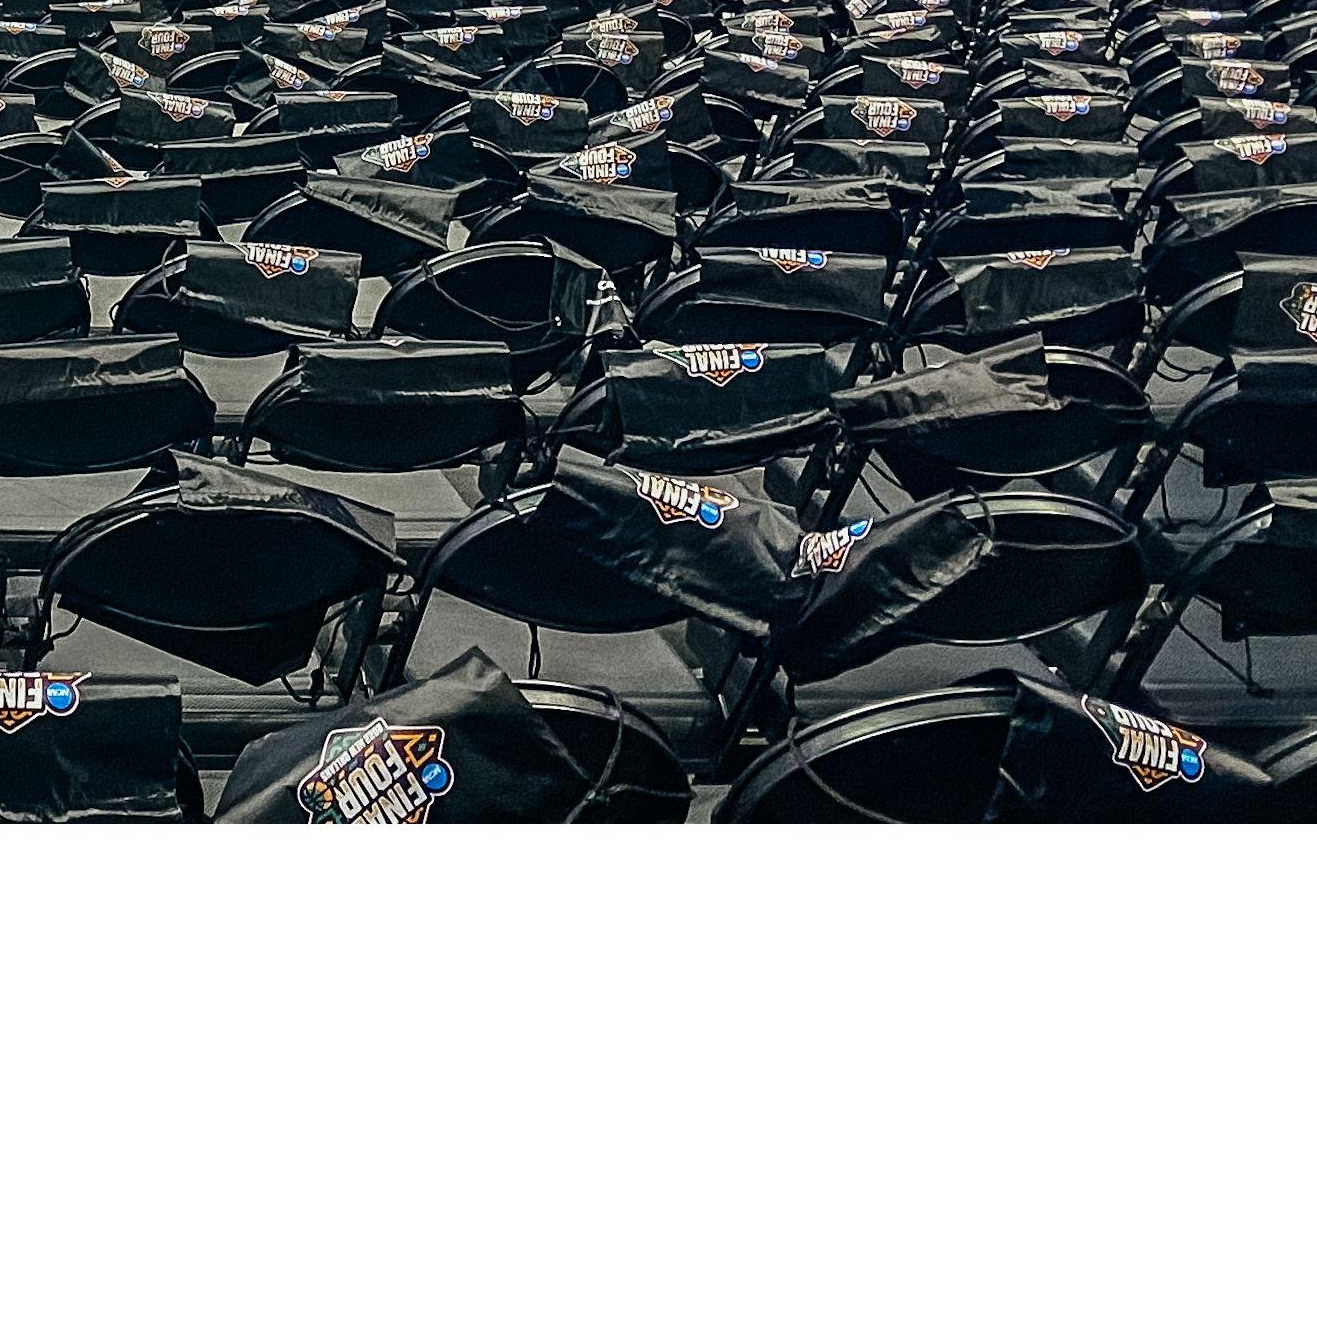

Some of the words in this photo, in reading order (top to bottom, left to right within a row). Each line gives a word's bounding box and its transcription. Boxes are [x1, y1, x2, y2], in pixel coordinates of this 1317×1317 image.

[686, 350, 741, 373] FINAL
[639, 475, 702, 514] FINAL
[1118, 722, 1181, 773] FINAL
[335, 740, 408, 808] FOUR
